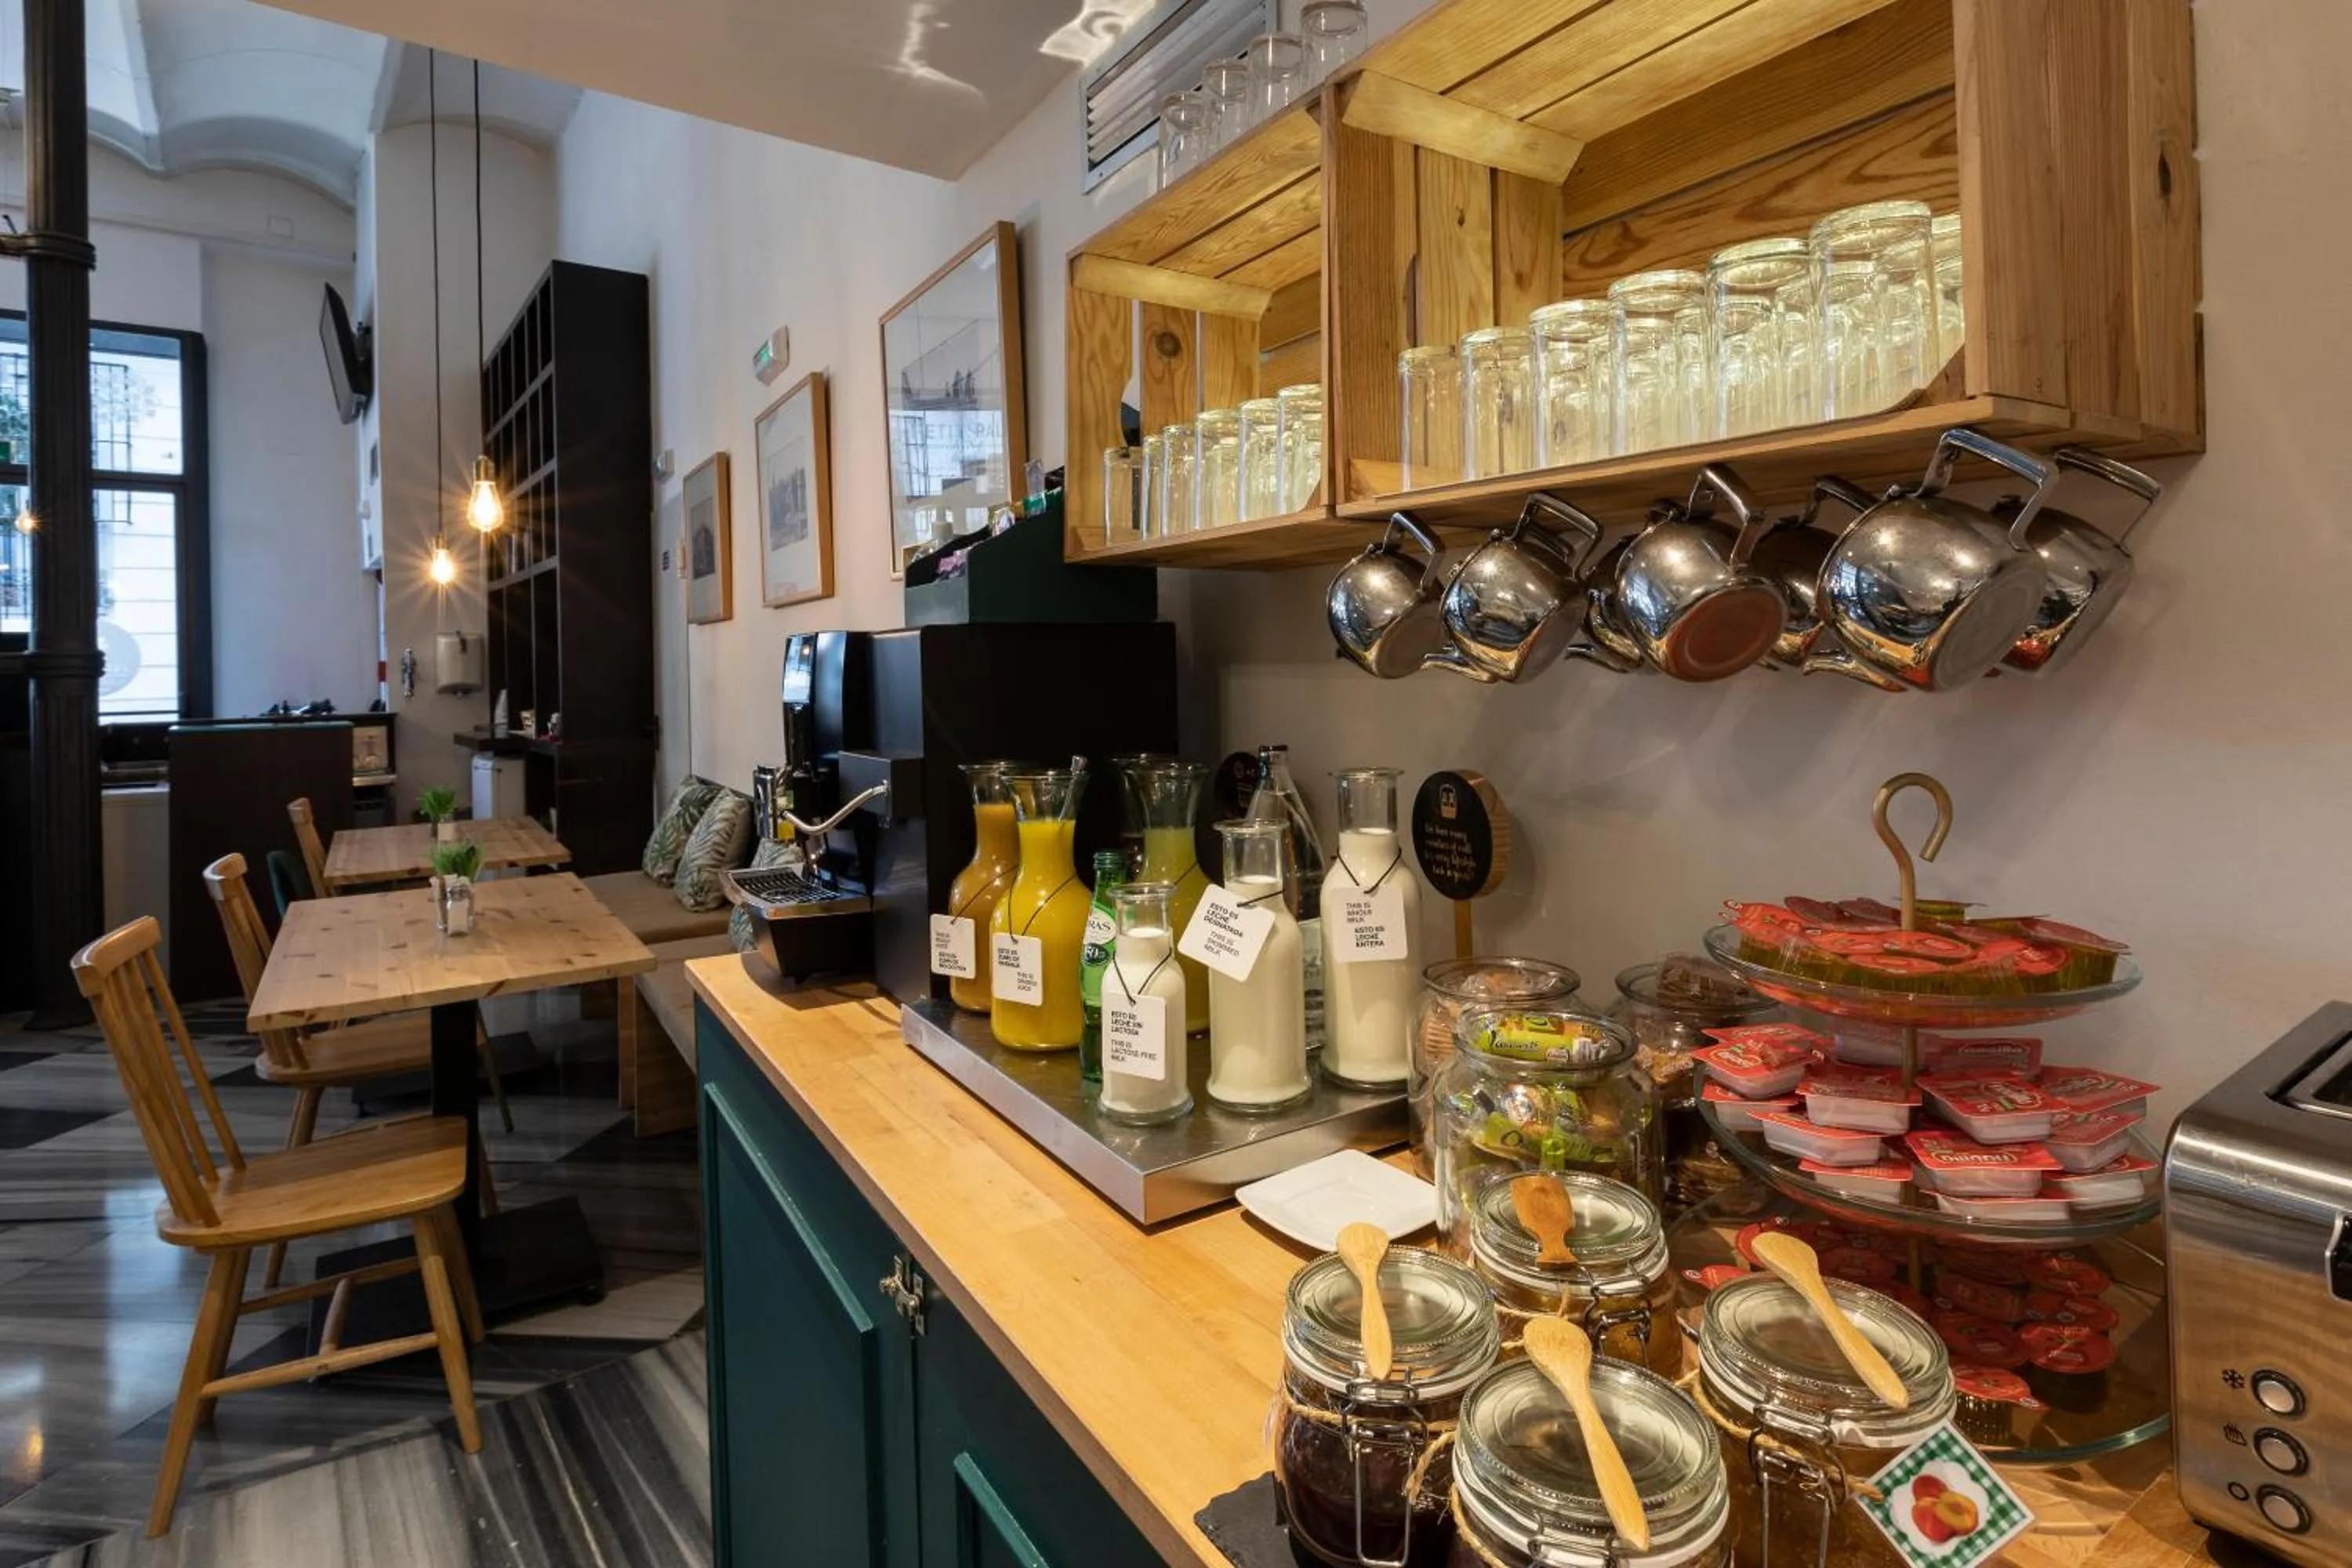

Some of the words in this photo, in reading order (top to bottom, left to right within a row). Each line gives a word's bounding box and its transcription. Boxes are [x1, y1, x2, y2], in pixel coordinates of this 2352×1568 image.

[1207, 909, 1229, 924] LECHE
[1210, 902, 1229, 915] ESTO
[1229, 910, 1239, 920] ES
[1203, 915, 1243, 938] DESNATADA
[1210, 931, 1226, 942] THIS
[1355, 933, 1380, 942] LECHE
[1203, 944, 1221, 957] MILK
[1207, 938, 1240, 956] SKIMMED
[1111, 1011, 1128, 1020] ESTO
[1111, 1018, 1131, 1027] LECHE
[1111, 1026, 1139, 1036] LACTOSA
[1111, 1039, 1125, 1047] THIS
